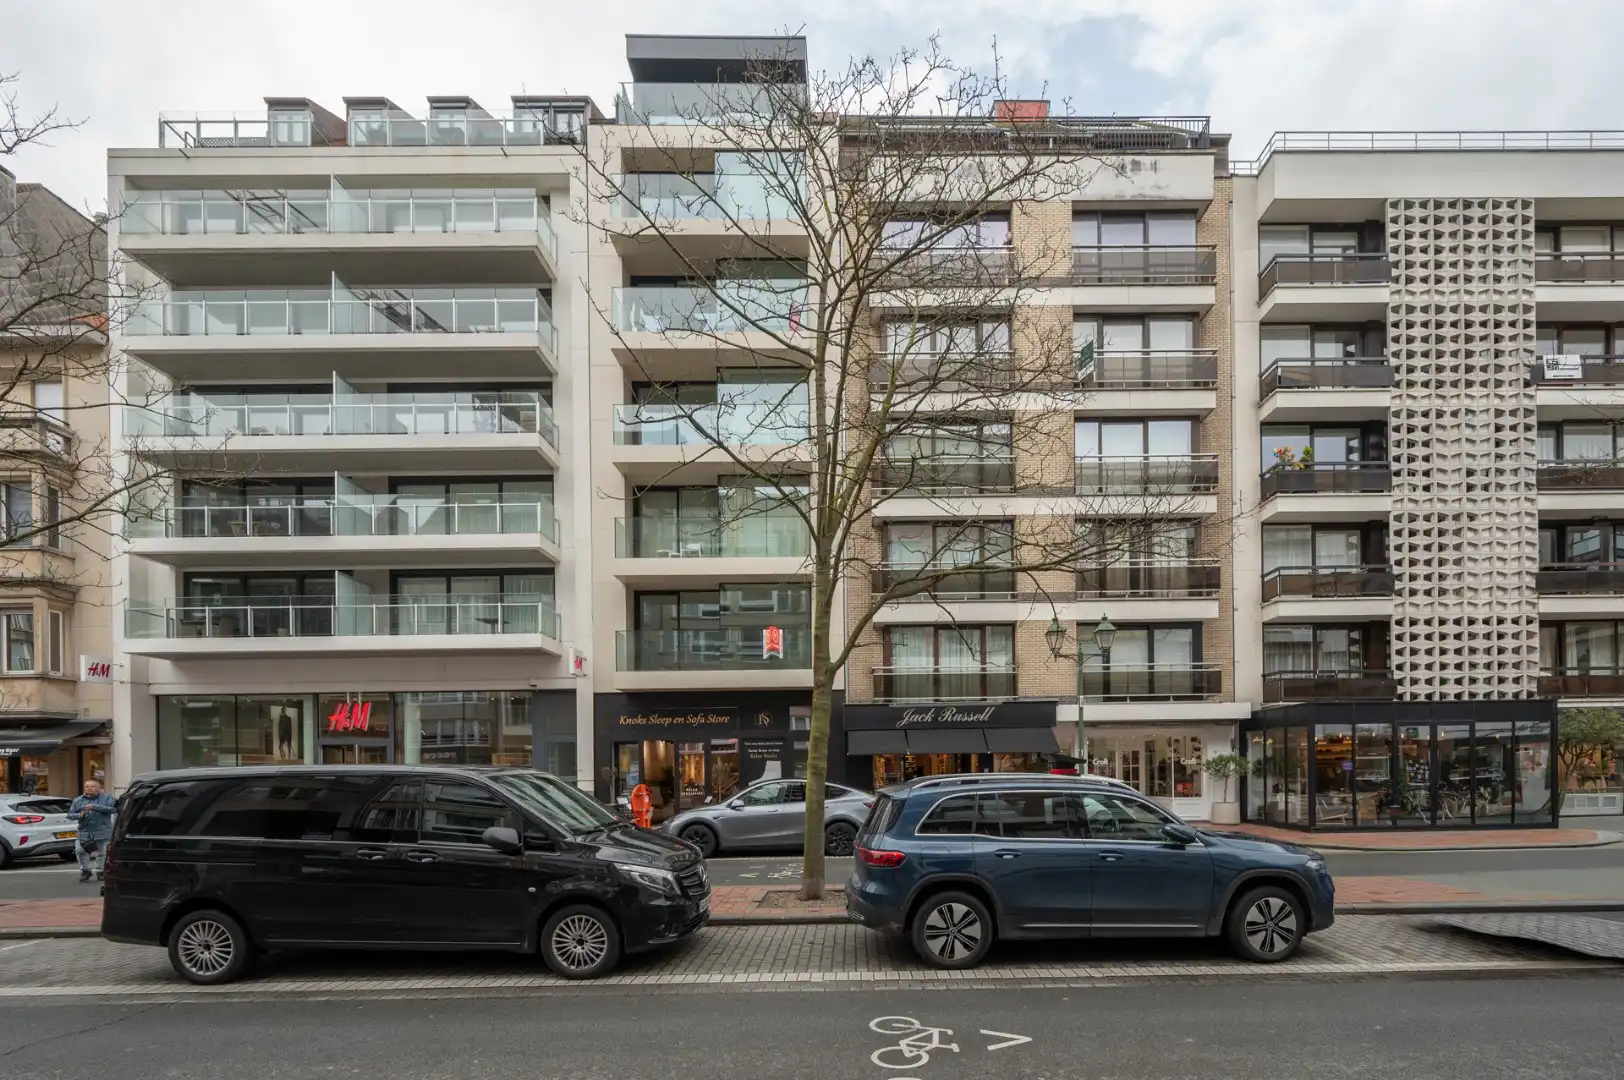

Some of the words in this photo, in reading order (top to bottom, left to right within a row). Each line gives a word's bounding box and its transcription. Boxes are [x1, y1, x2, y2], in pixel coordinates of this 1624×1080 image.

[87, 661, 111, 679] H&M
[327, 701, 372, 732] H&M
[619, 714, 647, 725] Knoks
[648, 713, 672, 727] Sleep
[673, 715, 685, 724] en
[686, 712, 705, 727] Sofa
[706, 713, 730, 724] Store
[896, 707, 936, 728] Jack
[938, 706, 996, 722] Russell
